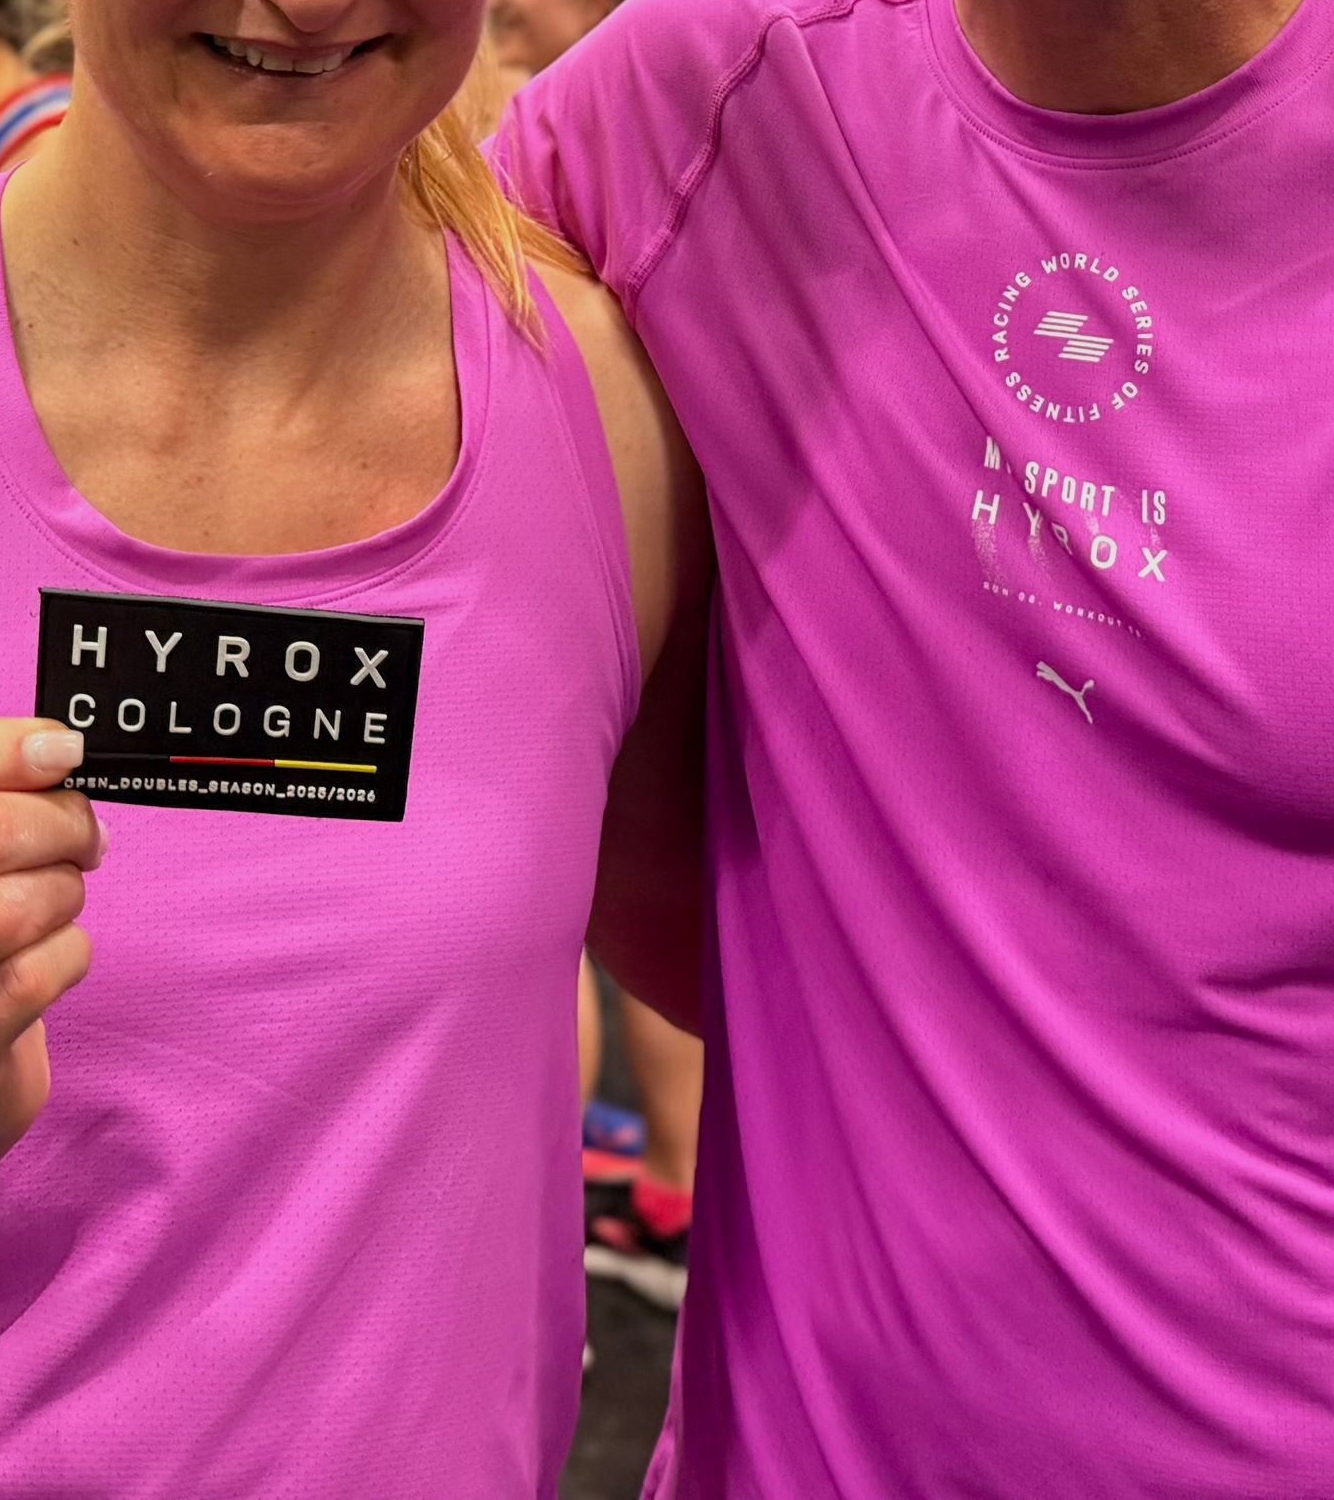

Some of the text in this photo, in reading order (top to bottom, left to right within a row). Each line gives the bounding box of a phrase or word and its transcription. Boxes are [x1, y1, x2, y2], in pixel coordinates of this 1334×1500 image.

[992, 253, 1154, 423] WORLD SERIES OF FITNESS RACING
[984, 436, 1166, 525] M SPORT IS
[983, 581, 1009, 596] RUN
[71, 624, 389, 689] HYROX
[68, 693, 388, 744] COLOGNE
